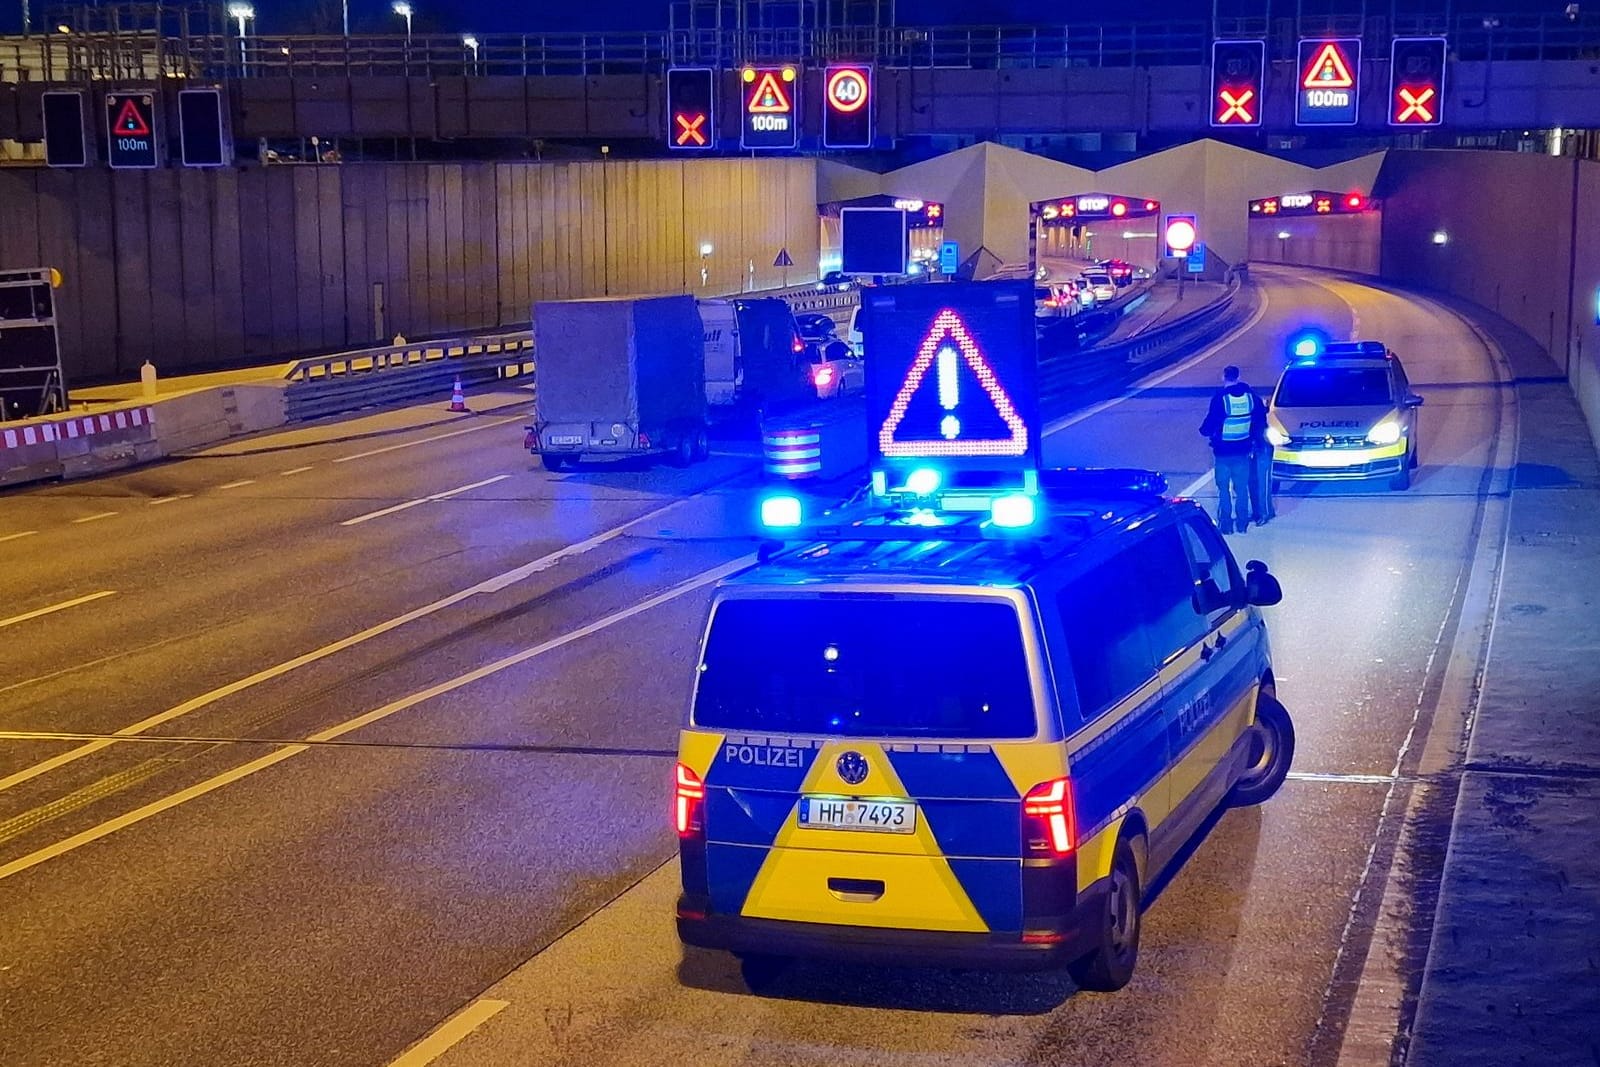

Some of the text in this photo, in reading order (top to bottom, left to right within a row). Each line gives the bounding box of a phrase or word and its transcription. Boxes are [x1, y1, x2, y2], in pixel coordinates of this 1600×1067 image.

[835, 80, 861, 100] 40
[1307, 91, 1348, 107] 100m
[752, 115, 788, 131] 100m
[118, 138, 148, 151] 100m
[1077, 198, 1109, 210] STOP
[1280, 195, 1313, 208] STOP
[1299, 420, 1360, 429] POLIZEI
[725, 745, 803, 767] POLIZEI
[819, 803, 844, 823] HH
[857, 804, 905, 825] 7493
